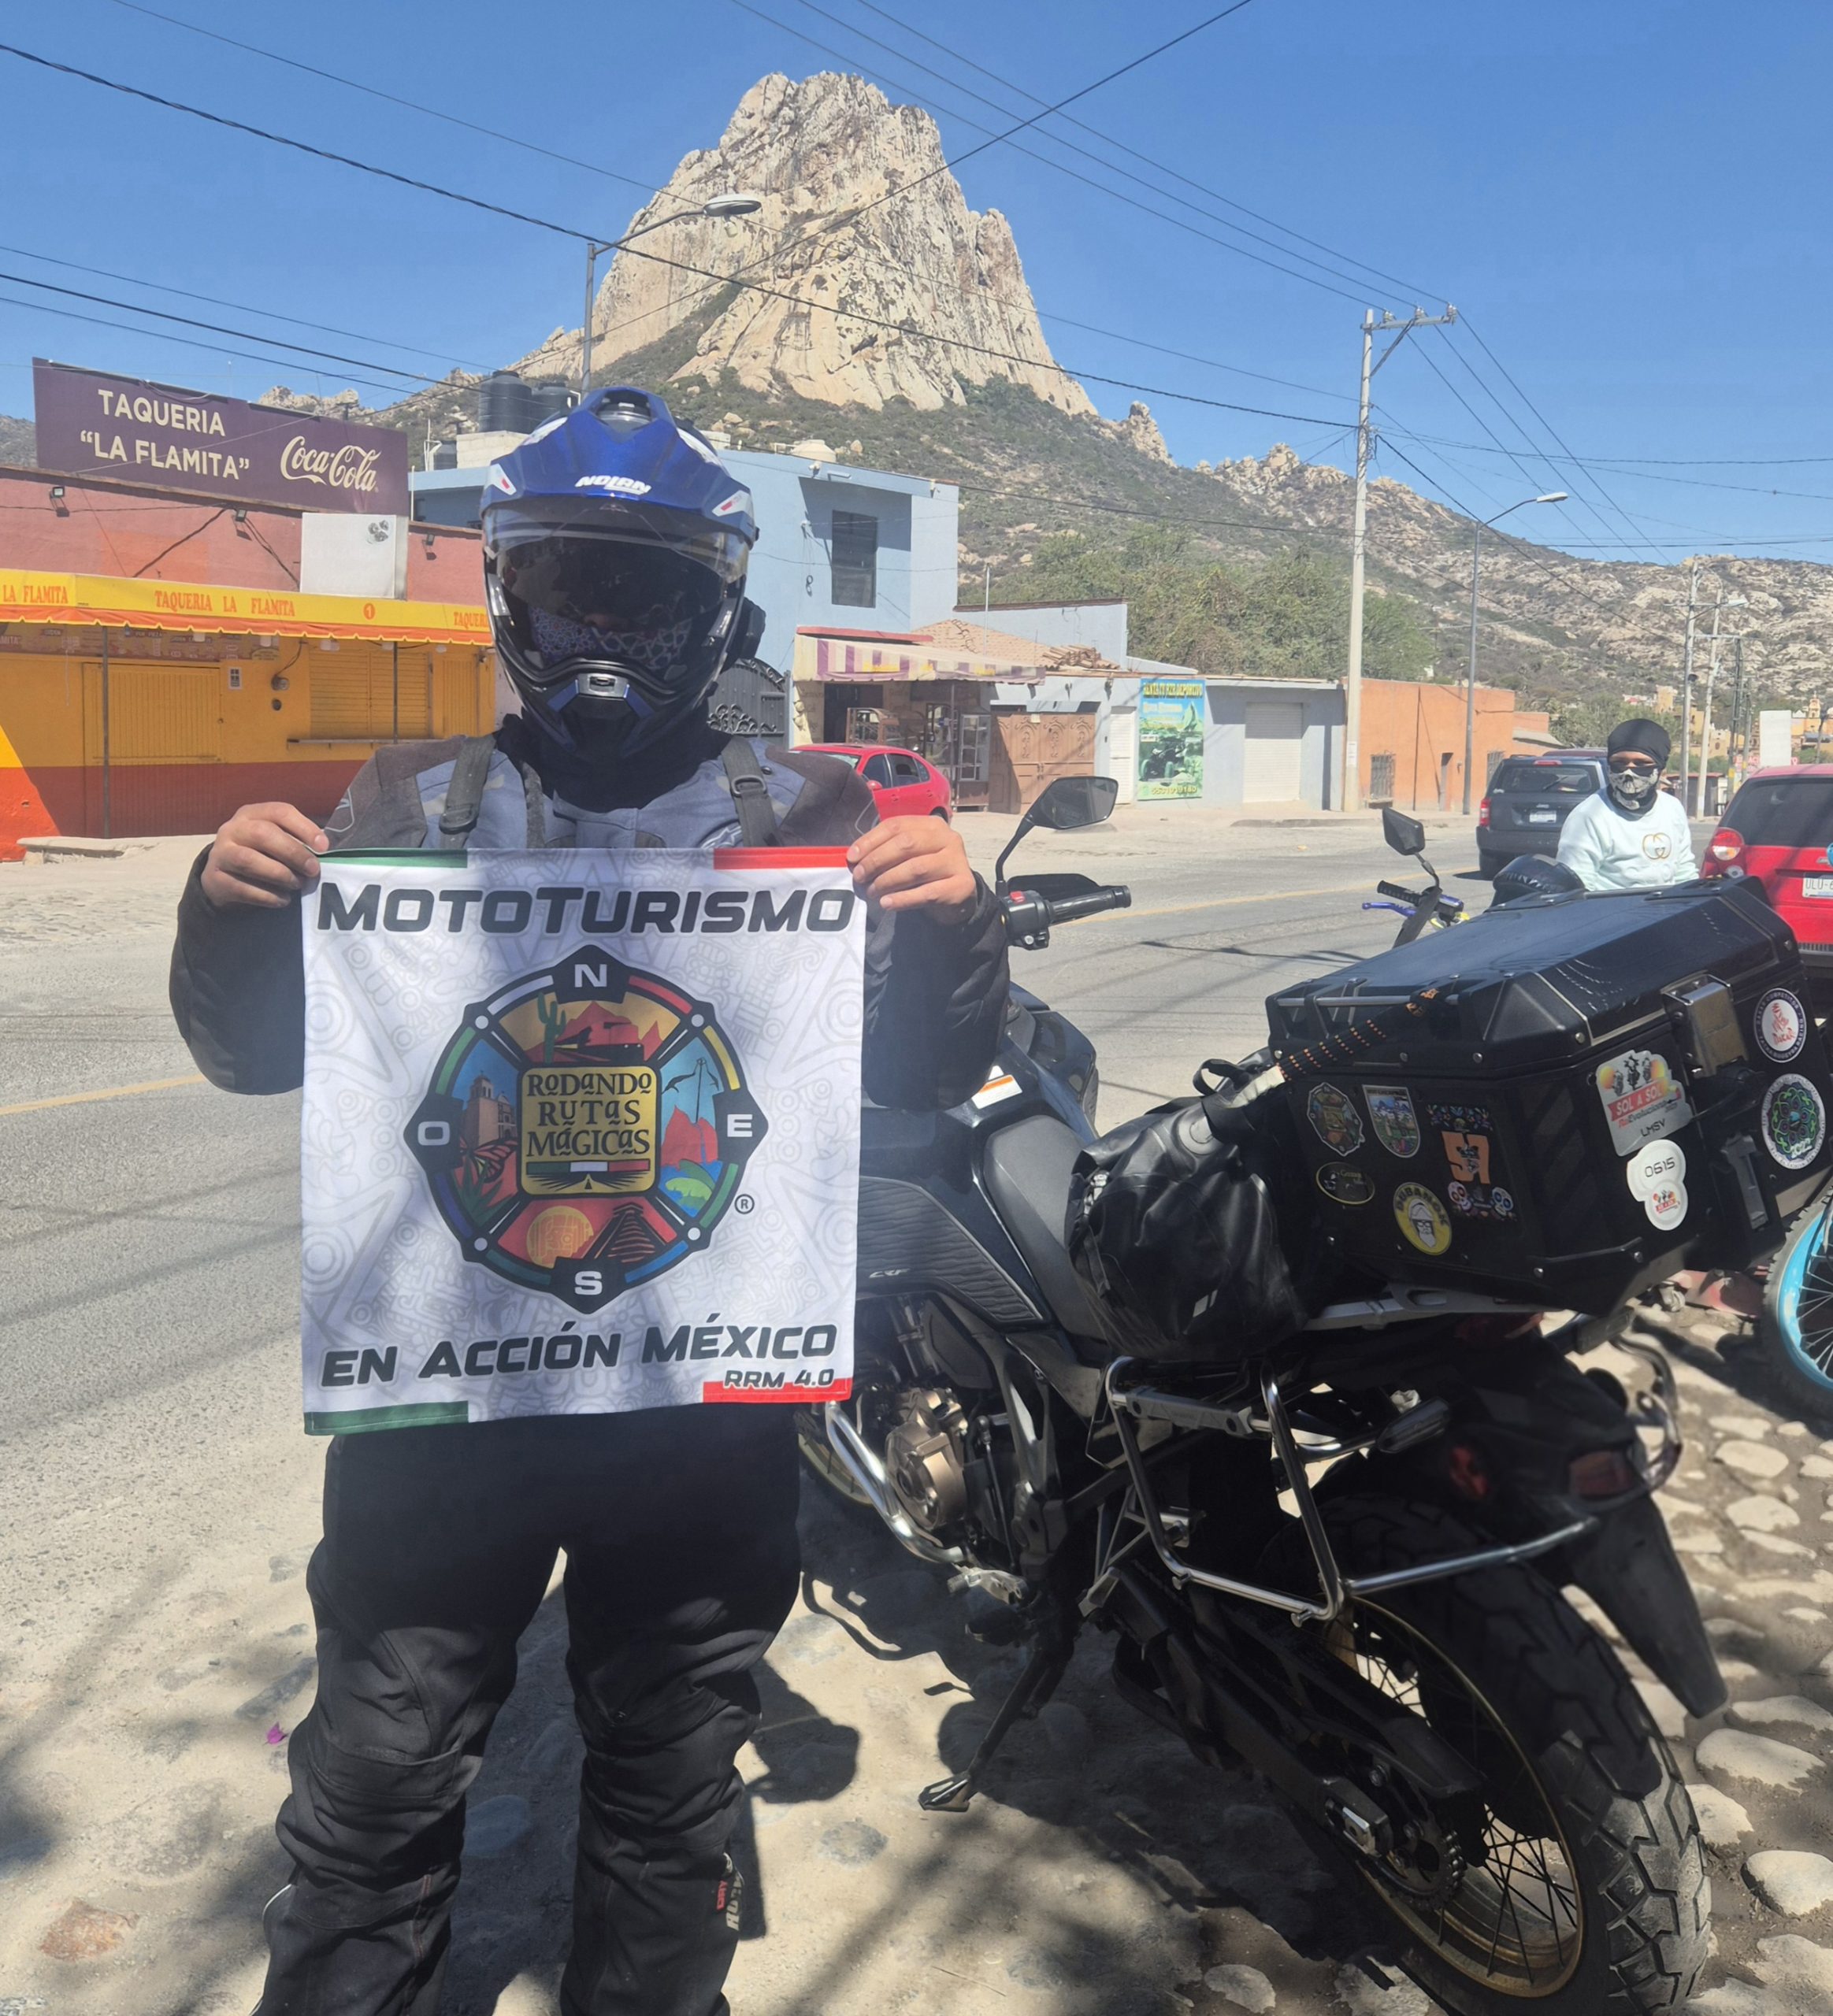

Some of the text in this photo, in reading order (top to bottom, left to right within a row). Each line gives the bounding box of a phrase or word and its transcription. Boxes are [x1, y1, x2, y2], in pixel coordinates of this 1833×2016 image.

[98, 388, 226, 437] TAQUERIA
[280, 435, 382, 492] Coca-Cola
[575, 475, 652, 495] NOLAN
[3, 584, 69, 604] LA FLAMITA
[154, 591, 295, 617] TAQUERIA LA FLAMITA
[317, 882, 855, 933] MOTOTURISMO
[575, 964, 607, 987] N
[1616, 1097, 1634, 1116] SOL
[418, 1121, 450, 1146] O
[728, 1114, 752, 1137] E
[1645, 1157, 1675, 1177] 0615
[575, 1271, 603, 1295] S
[321, 1312, 838, 1388] EN ACCIÓN MÉXICO
[723, 1368, 835, 1390] RRM 4.0
